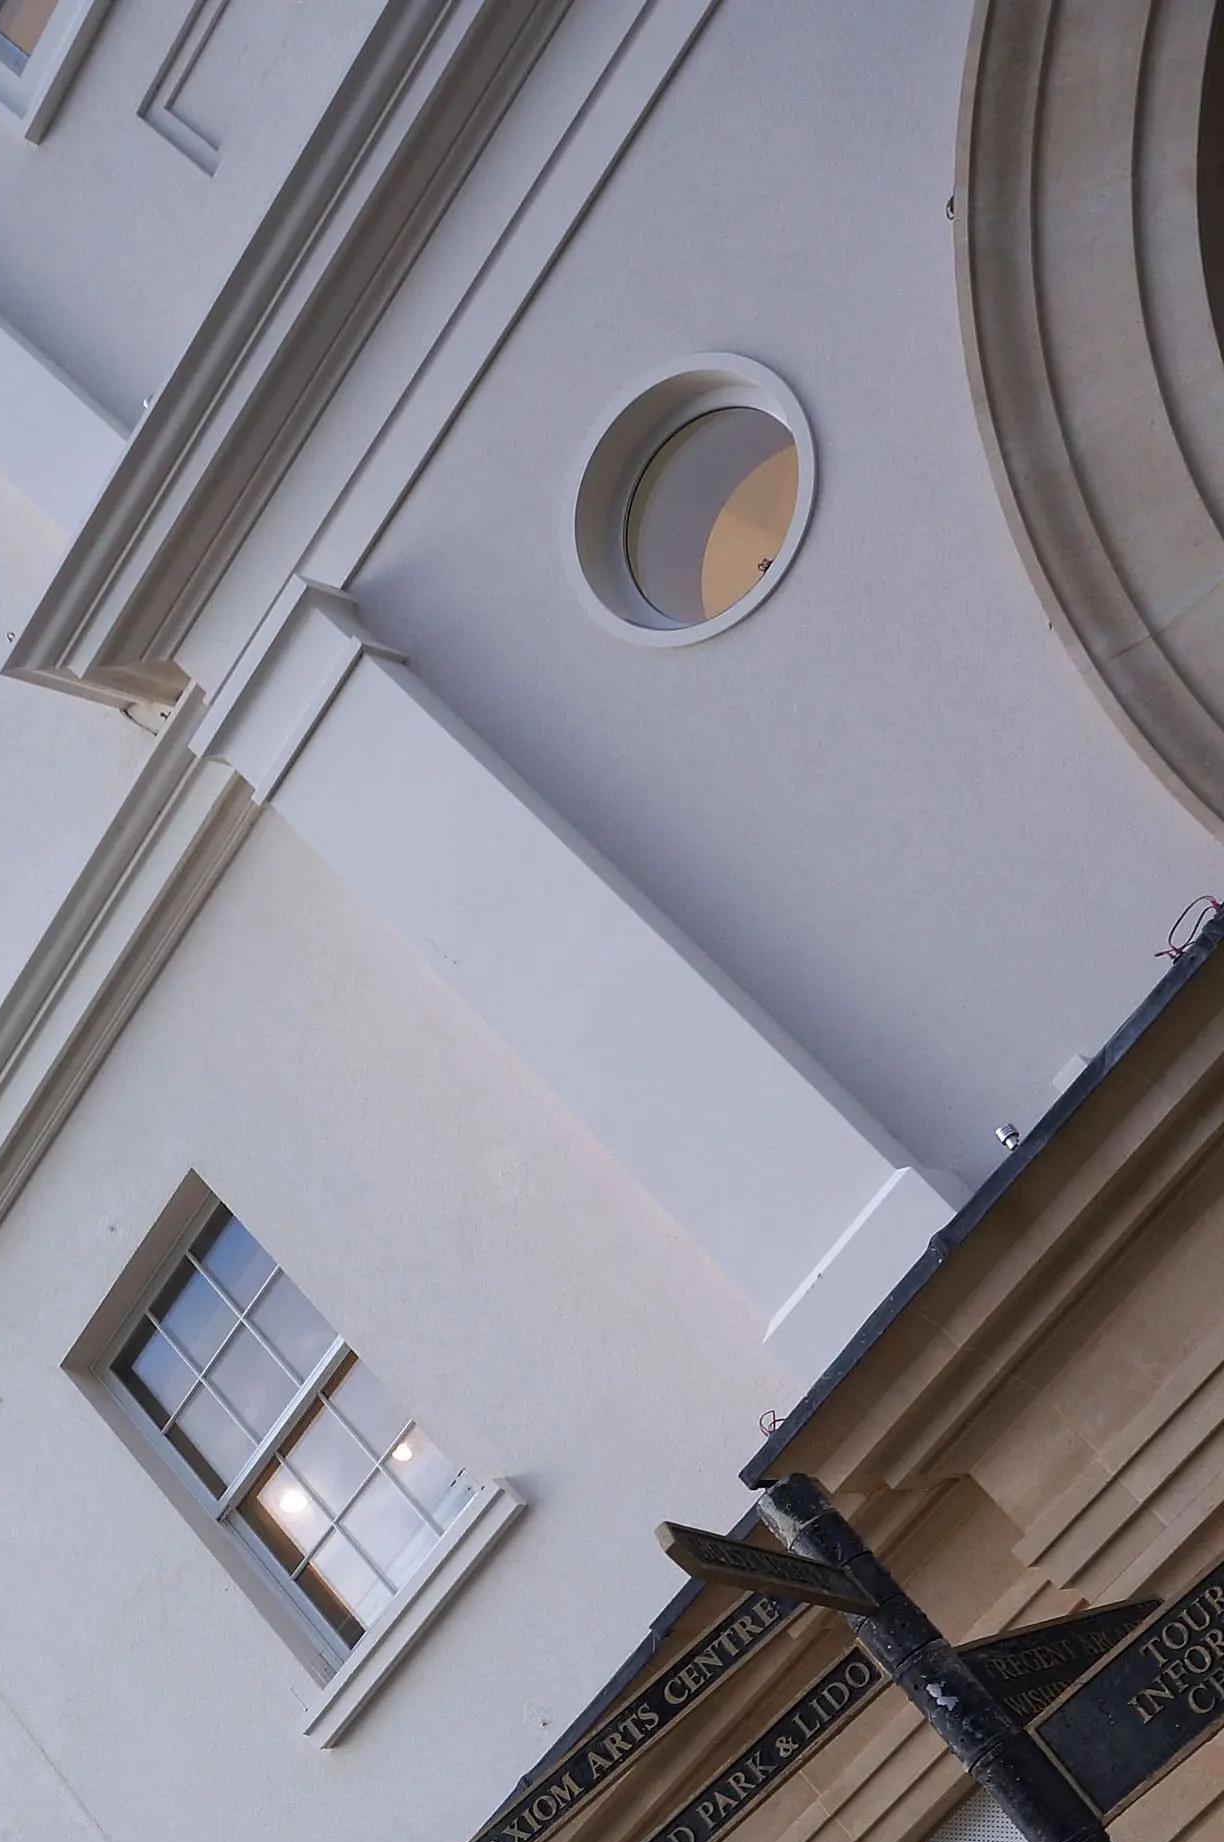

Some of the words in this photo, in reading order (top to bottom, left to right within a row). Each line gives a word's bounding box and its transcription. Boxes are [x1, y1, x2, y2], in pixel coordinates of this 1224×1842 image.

[585, 1702, 660, 1780] ARTS
[663, 1596, 780, 1705] CENTRE
[989, 1640, 1076, 1681] REGENT
[695, 1750, 777, 1830] PARK
[775, 1735, 799, 1758] &
[791, 1661, 871, 1740] LIDO
